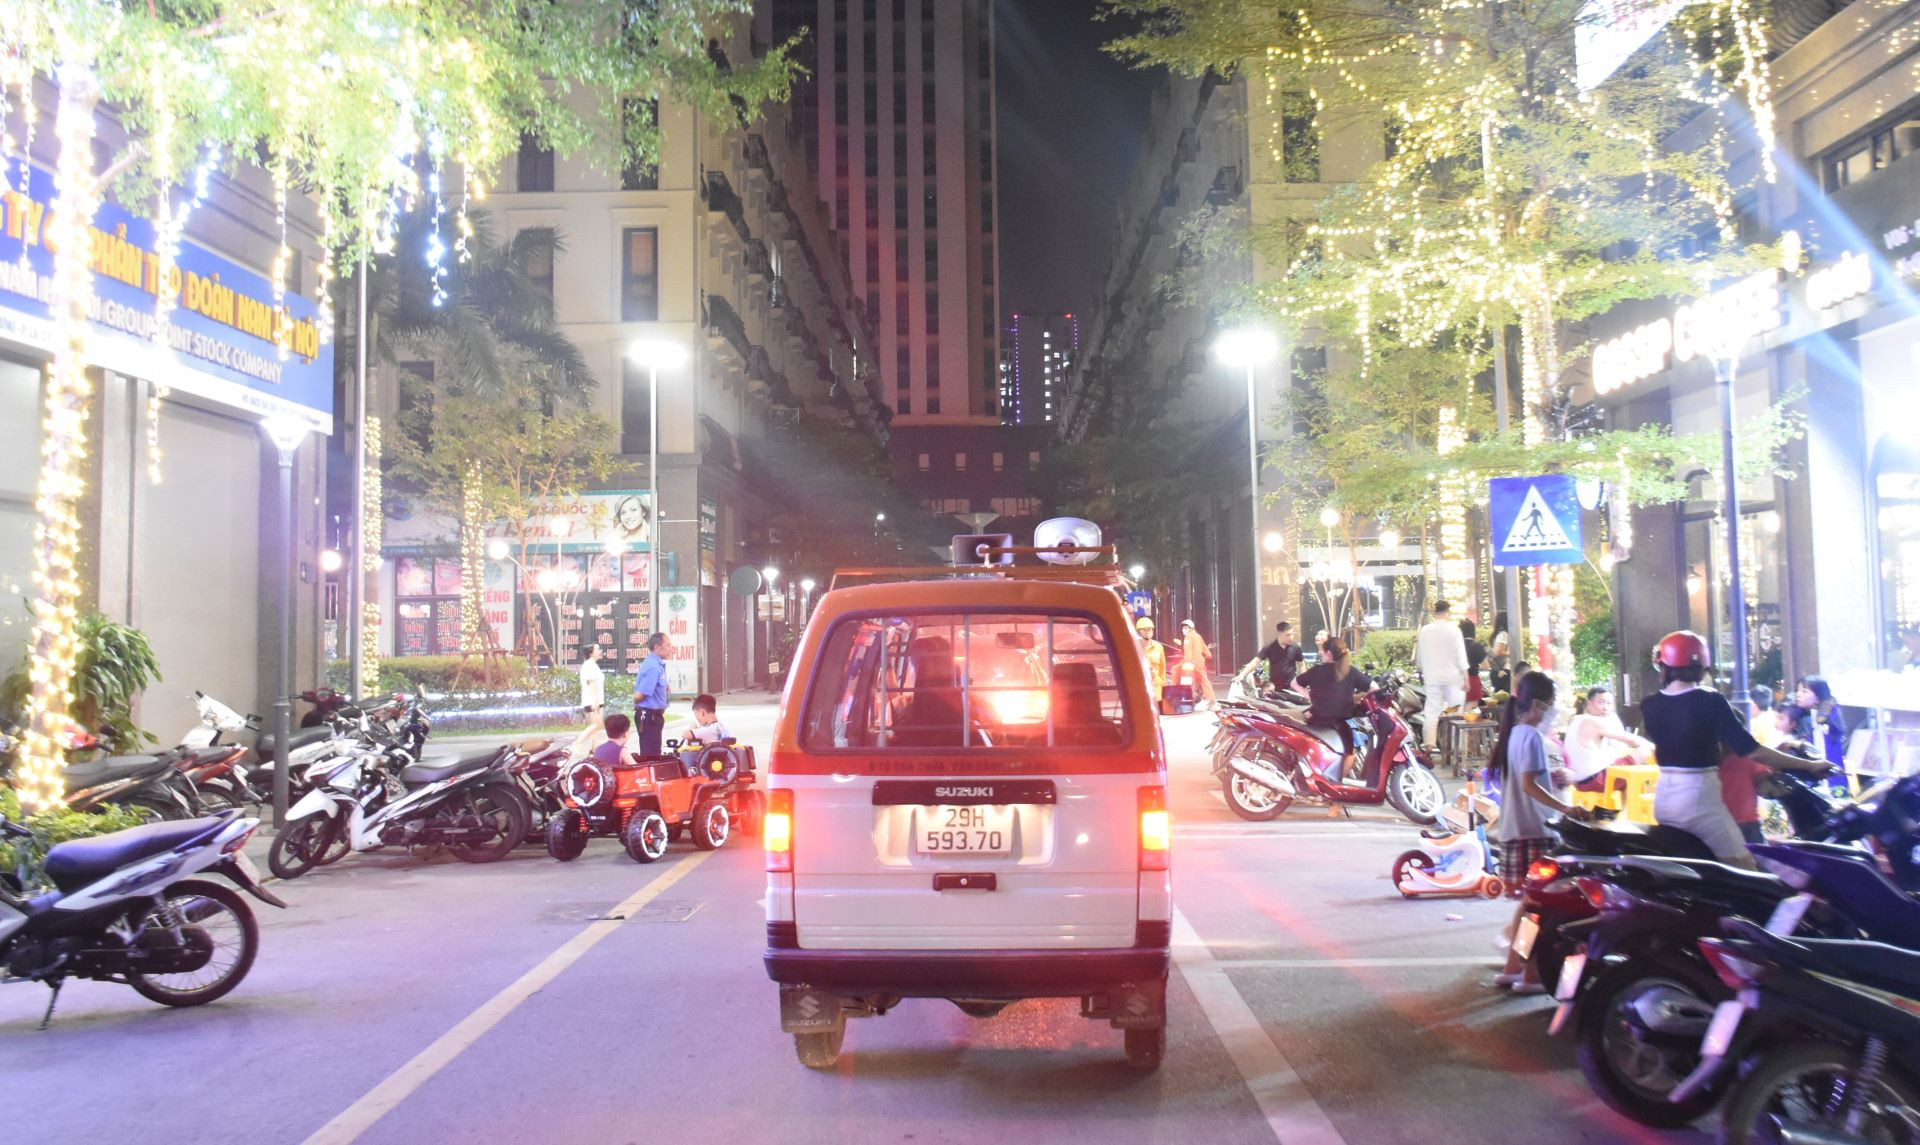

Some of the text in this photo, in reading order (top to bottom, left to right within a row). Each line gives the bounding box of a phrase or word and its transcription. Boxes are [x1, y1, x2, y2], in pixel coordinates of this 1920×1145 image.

[183, 271, 234, 324] ĐOÀN
[237, 293, 271, 342] NAM
[194, 333, 233, 366] STOCK
[232, 345, 283, 384] COMPANY
[935, 787, 993, 797] SUZUKI
[945, 808, 984, 828] 29H
[927, 831, 1002, 850] 593.70
